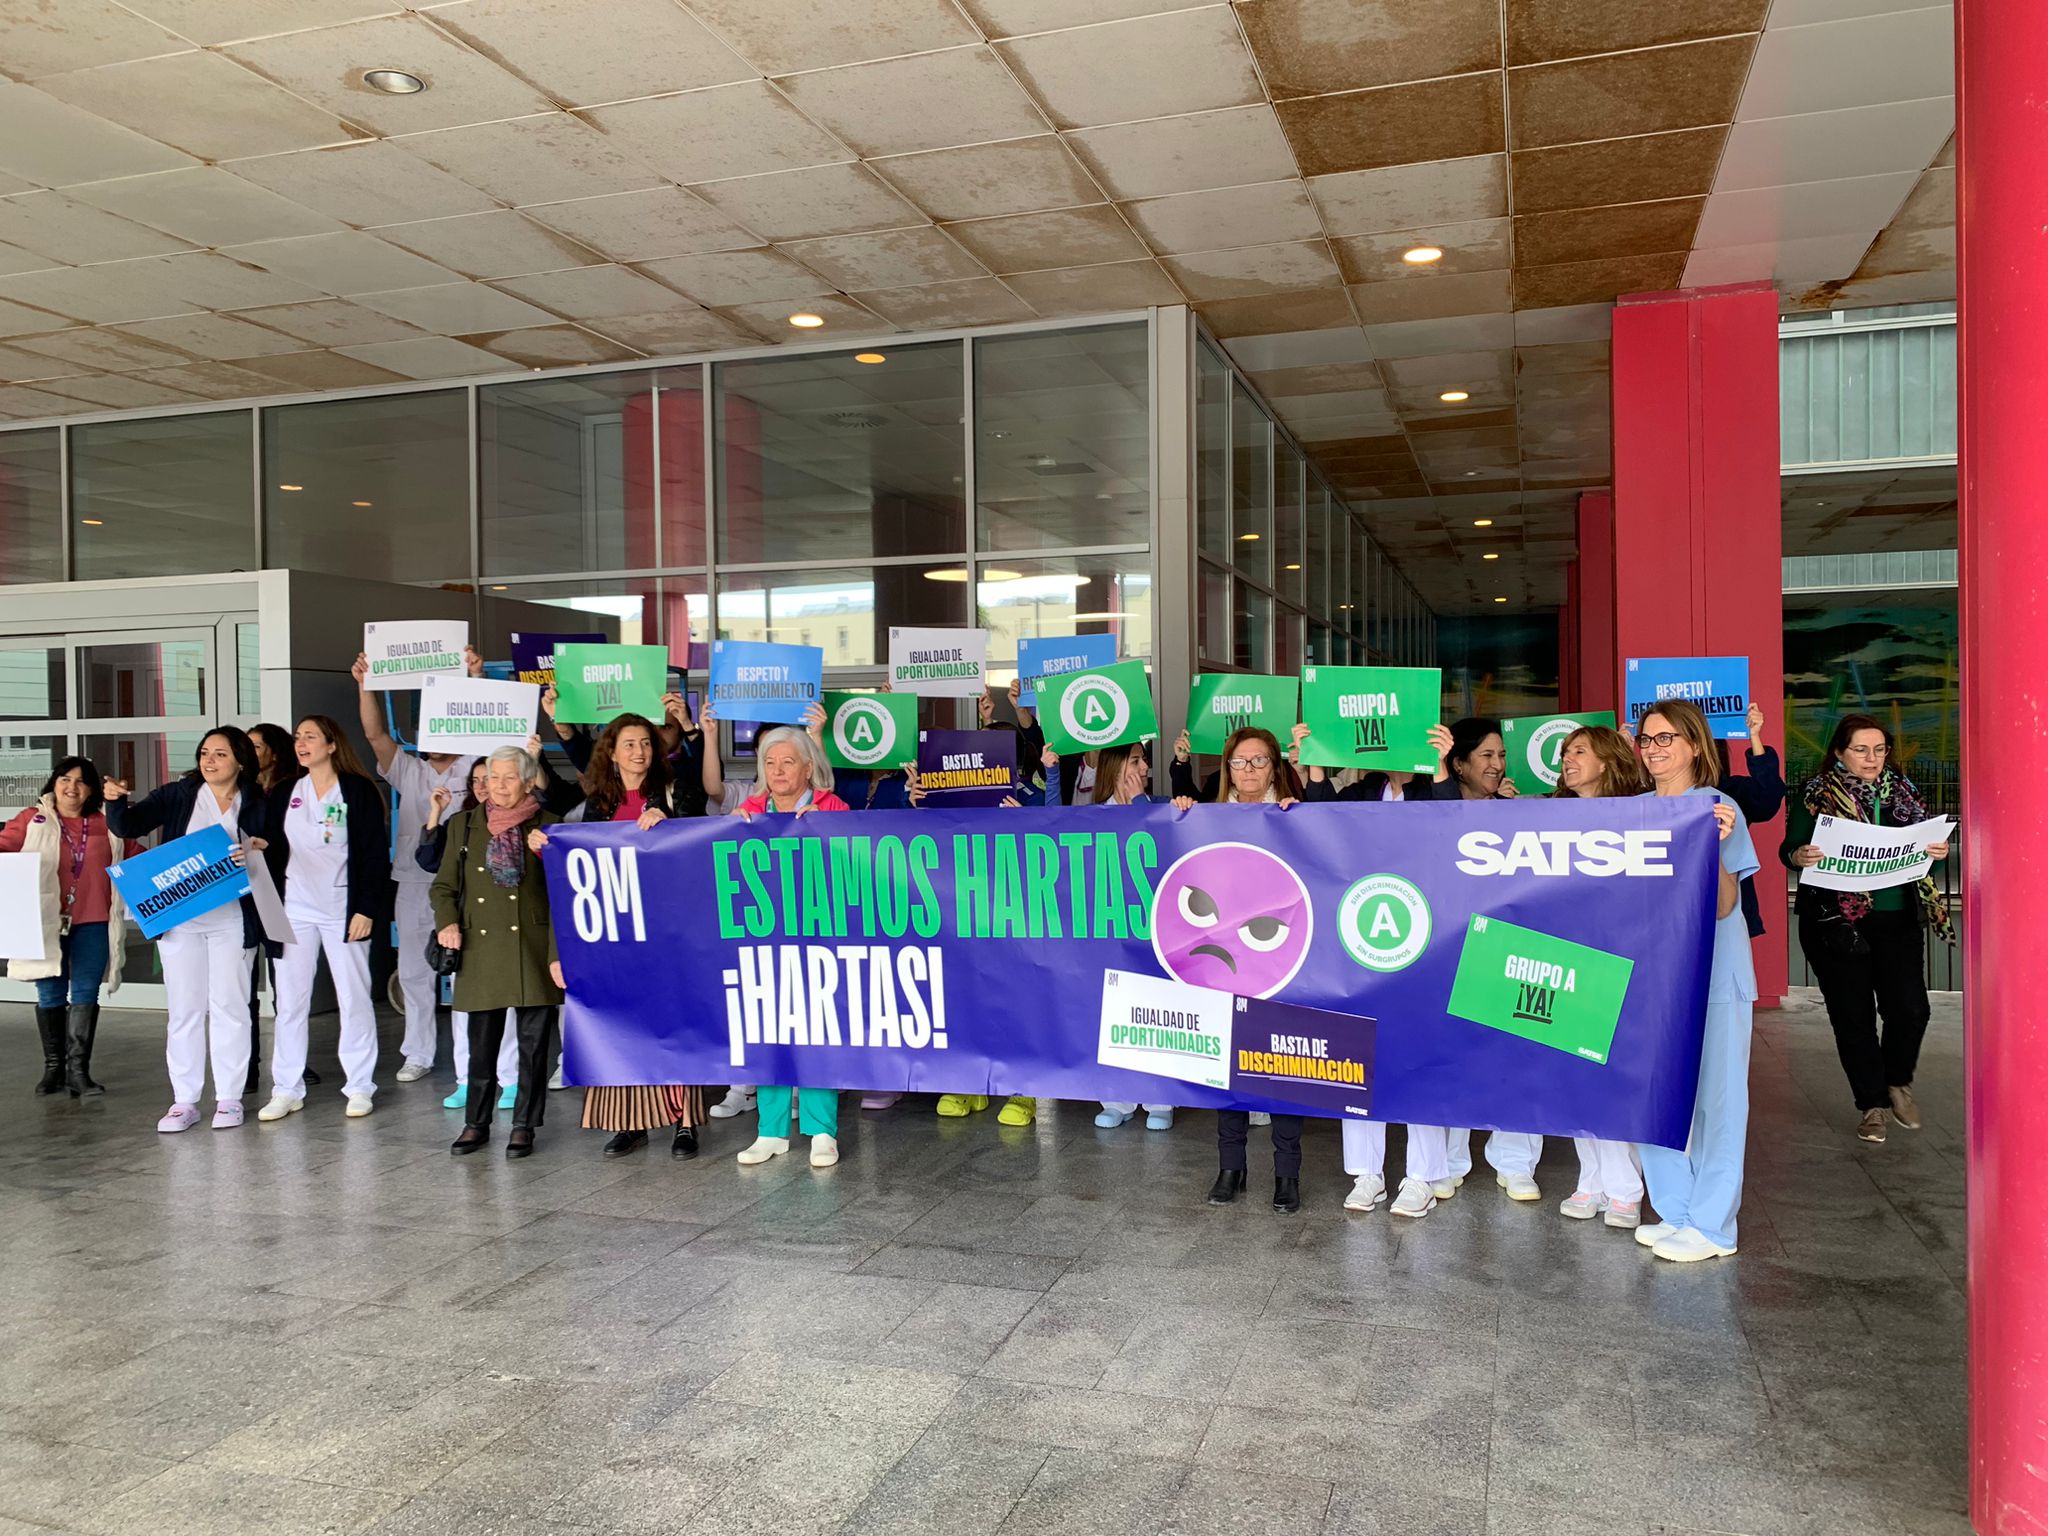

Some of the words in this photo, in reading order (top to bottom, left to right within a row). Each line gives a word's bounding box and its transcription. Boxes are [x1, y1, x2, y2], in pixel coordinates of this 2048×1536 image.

[386, 640, 430, 657] IGUALDAD
[432, 639, 443, 652] DE
[909, 649, 951, 664] IGUALDAD
[952, 648, 963, 661] DE
[372, 652, 461, 674] OPORTUNIDADES
[537, 655, 556, 669] BAS
[896, 661, 979, 679] OPORTUNIDADES
[1043, 656, 1080, 673] RESPETO
[1080, 655, 1088, 668] Y
[583, 664, 622, 683] GRUPO
[625, 663, 633, 681] A
[737, 666, 781, 681] RESPETO
[782, 666, 789, 680] Y
[596, 683, 622, 705] ¡YA!
[713, 682, 815, 699] RECONOCIMIENTO
[1656, 681, 1704, 699] RESPETO
[1705, 680, 1712, 696] Y
[446, 702, 495, 716] IGUALDAD
[497, 702, 510, 716] DE
[1084, 695, 1109, 724] A
[1212, 695, 1252, 714] GRUPO
[1255, 695, 1263, 713] A
[1338, 693, 1387, 718] GRUPO
[1389, 692, 1399, 716] A
[429, 718, 528, 733] OPORTUNIDADES
[851, 716, 875, 743] A
[1355, 718, 1386, 745] ¡YA!
[942, 754, 972, 771] BASTA
[971, 752, 985, 769] DE
[920, 764, 1011, 789] DISCRIMINACIÓN
[1821, 815, 1834, 828] 8M
[1455, 830, 1673, 876] SATSE
[1841, 844, 1901, 860] IGUALDAD
[1902, 842, 1917, 854] DE
[152, 855, 201, 890] RESPETO
[196, 852, 208, 867] Y
[1817, 850, 1929, 874] OPORTUNIDADES
[566, 846, 647, 943] 8M
[712, 834, 942, 939] ESTAMOS
[953, 831, 1158, 940] HARTAS
[1351, 893, 1361, 905] SIN
[1369, 902, 1400, 938] A
[1474, 916, 1488, 934] 8M
[1357, 944, 1367, 956] SIN
[1368, 948, 1411, 963] SUBGRUPOS
[1108, 972, 1118, 986] 8M
[1505, 954, 1563, 989] GRUPO
[1564, 968, 1576, 992] A
[722, 945, 948, 1067] ¡HARTAS!
[1236, 997, 1247, 1012] 8M
[1516, 983, 1555, 1018] ¡YA!
[1131, 1006, 1184, 1029] IGUALDAD
[1186, 1013, 1200, 1031] DE
[1111, 1024, 1221, 1056] OPORTUNIDADES
[1270, 1033, 1310, 1056] BASTA
[1311, 1038, 1329, 1058] DE
[1238, 1049, 1364, 1084] DISCRIMINACIÓN
